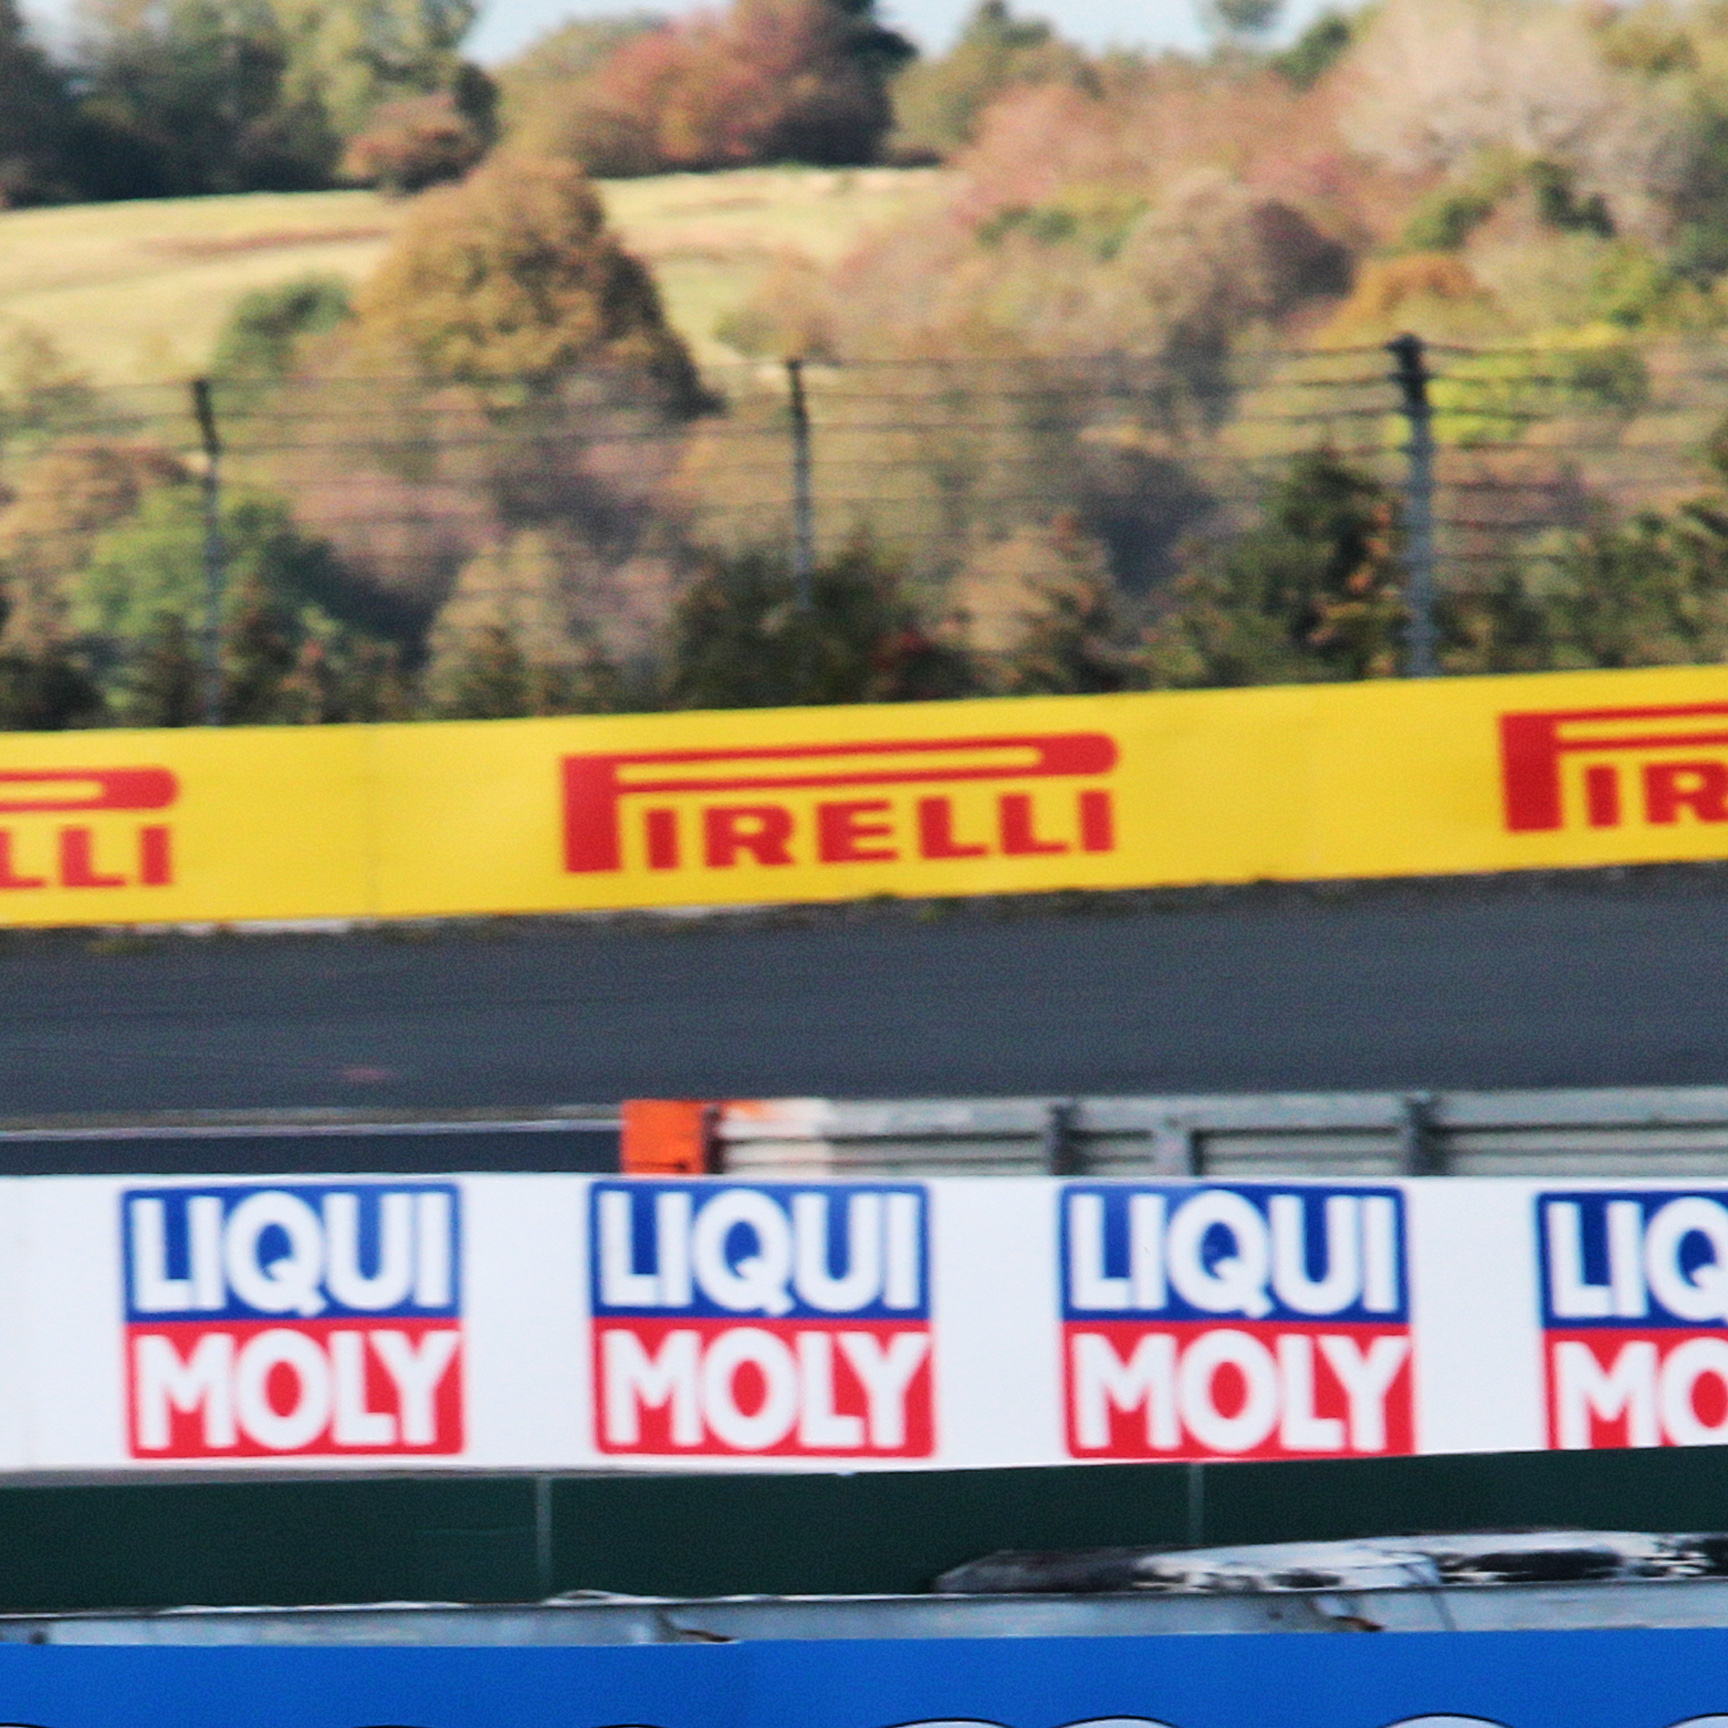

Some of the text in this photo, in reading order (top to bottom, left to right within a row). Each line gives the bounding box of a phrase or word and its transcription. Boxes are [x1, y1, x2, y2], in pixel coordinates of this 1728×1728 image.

[561, 731, 1118, 872] PIRELLI
[134, 1191, 452, 1318] LIQUI
[601, 1190, 924, 1318] LIQUI
[1071, 1192, 1404, 1320] LIQUI
[136, 1328, 459, 1452] MOLY
[601, 1328, 929, 1451] MOLY
[1072, 1330, 1410, 1455] MOLY
